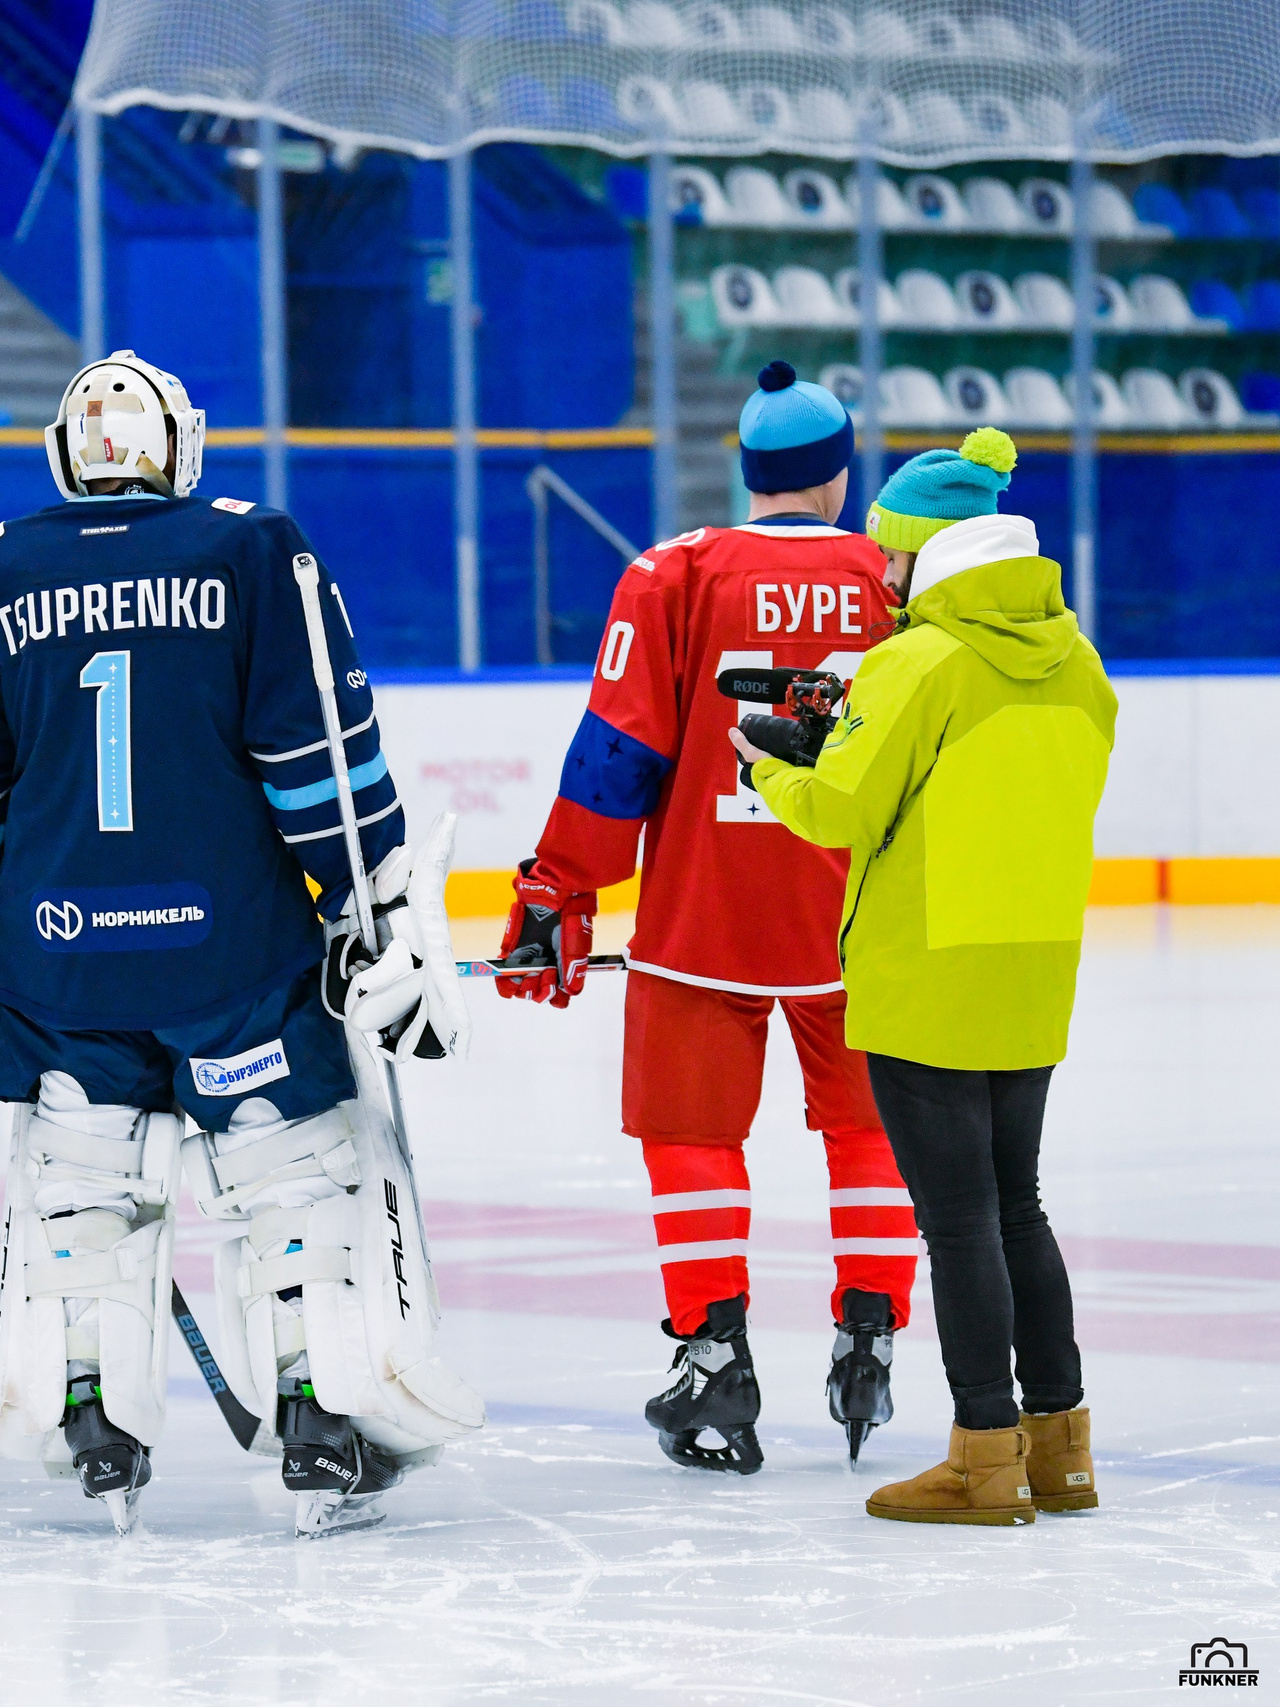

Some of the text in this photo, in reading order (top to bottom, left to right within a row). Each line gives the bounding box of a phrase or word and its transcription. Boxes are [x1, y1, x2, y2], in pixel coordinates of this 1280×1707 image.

[755, 583, 862, 635] БУРЕ
[732, 679, 770, 695] RØDE
[79, 650, 134, 832] 1
[419, 760, 530, 783] MOTOR
[91, 905, 205, 928] НОРНИКЕЛЬ
[226, 1051, 283, 1083] БУРЭНЕРГО
[383, 1177, 411, 1321] TRUE
[1072, 1474, 1086, 1482] UGG
[1021, 1488, 1030, 1496] UG
